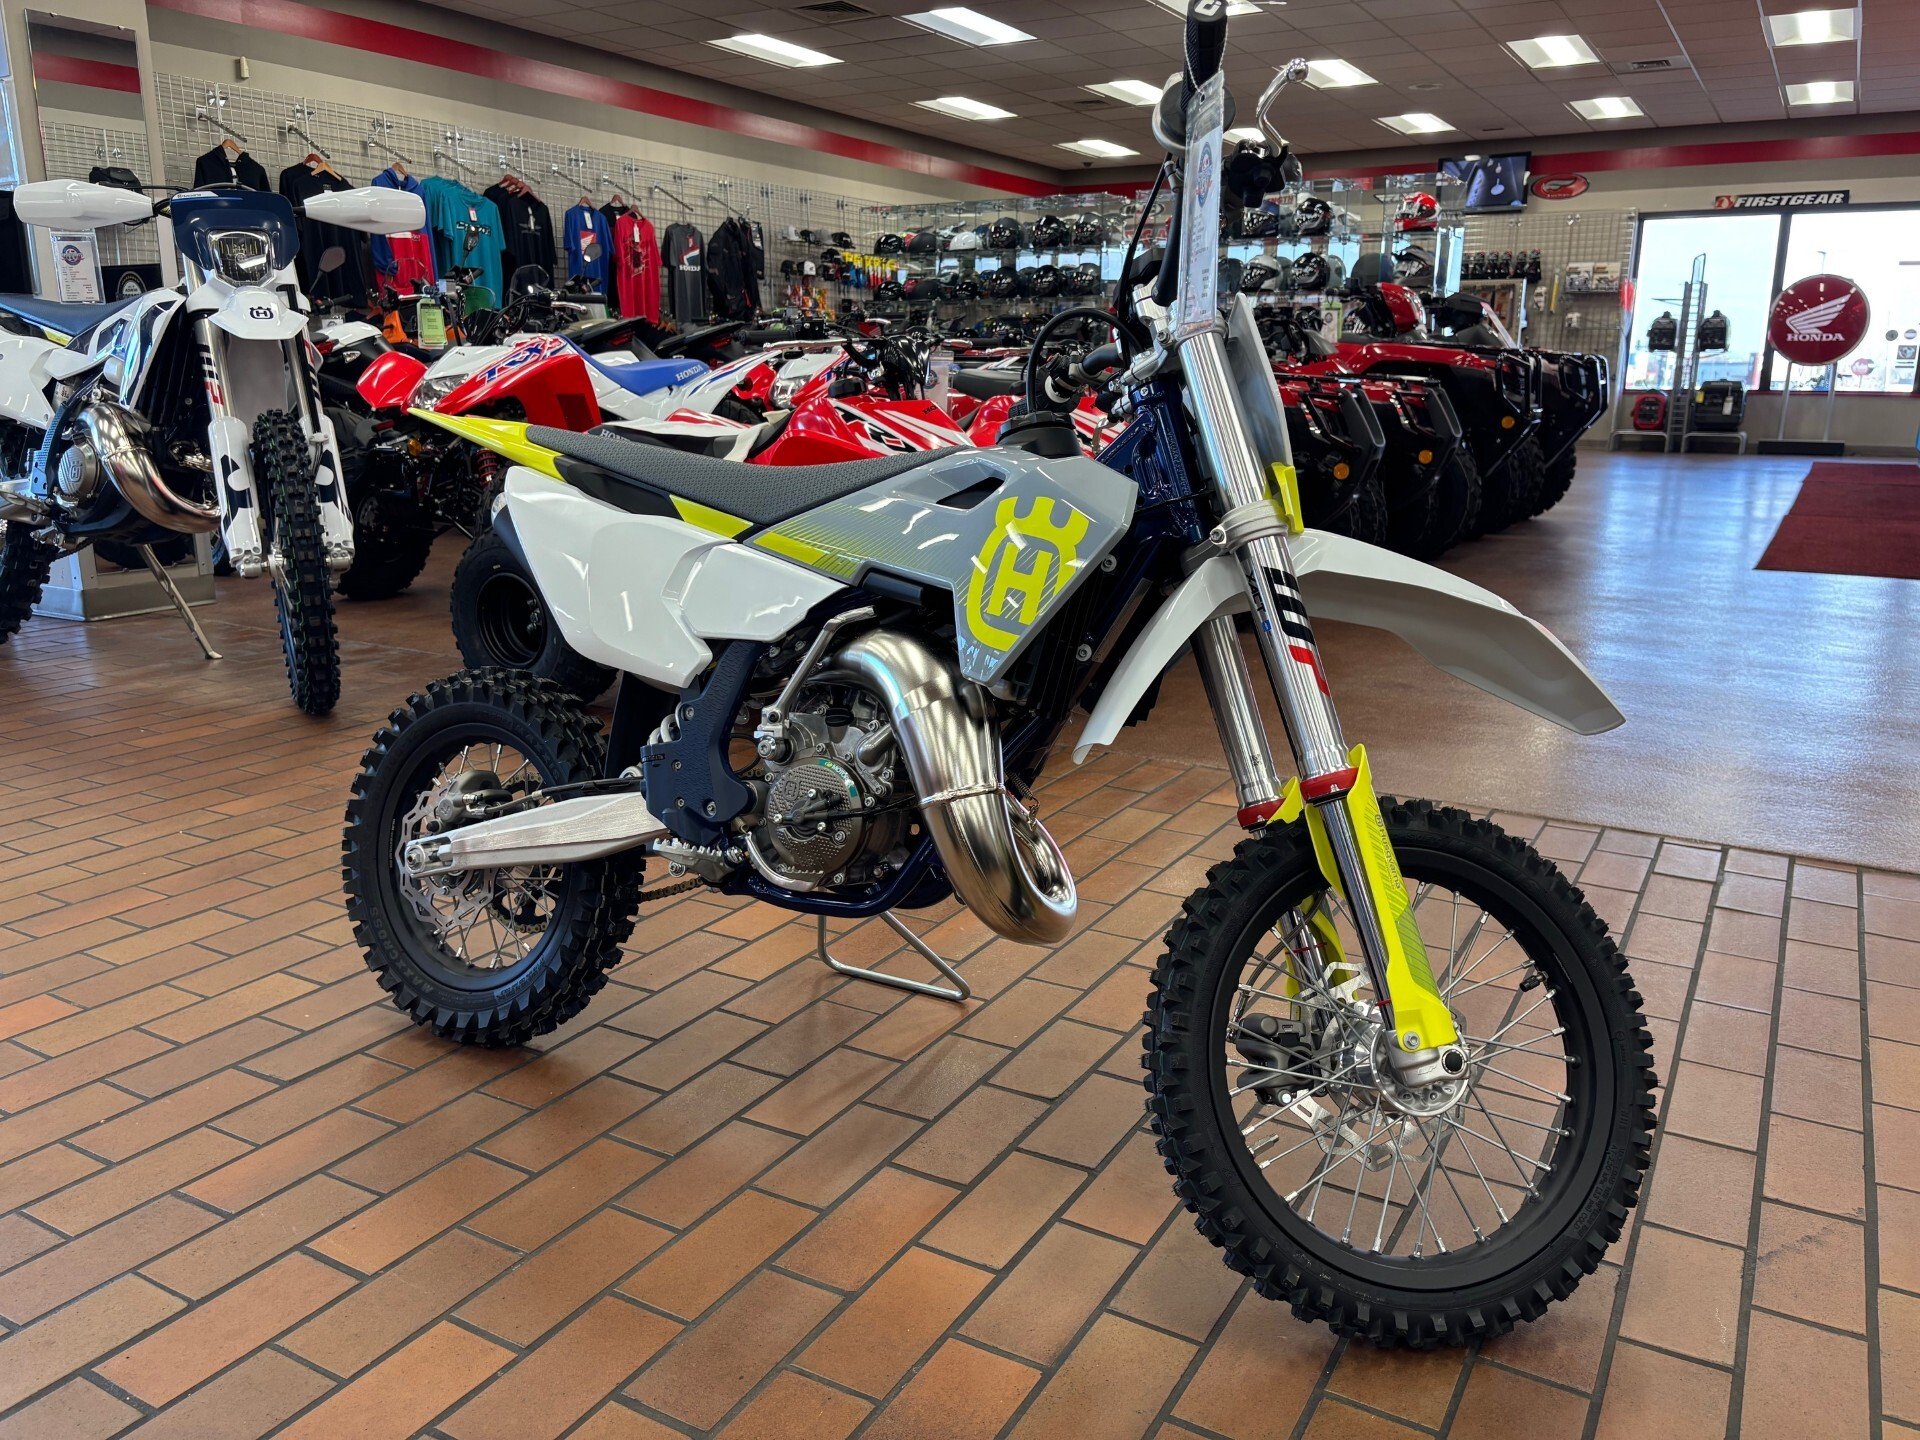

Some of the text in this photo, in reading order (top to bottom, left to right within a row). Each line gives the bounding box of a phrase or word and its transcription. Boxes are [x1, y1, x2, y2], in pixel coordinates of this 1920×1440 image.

[1734, 193, 1845, 207] FIRSTGEAR
[1786, 333, 1846, 342] HONDA
[676, 364, 704, 382] HONDA
[1245, 570, 1267, 612] XACT
[1379, 829, 1401, 889] Husqvarna
[369, 906, 434, 993] MAXXCROSS
